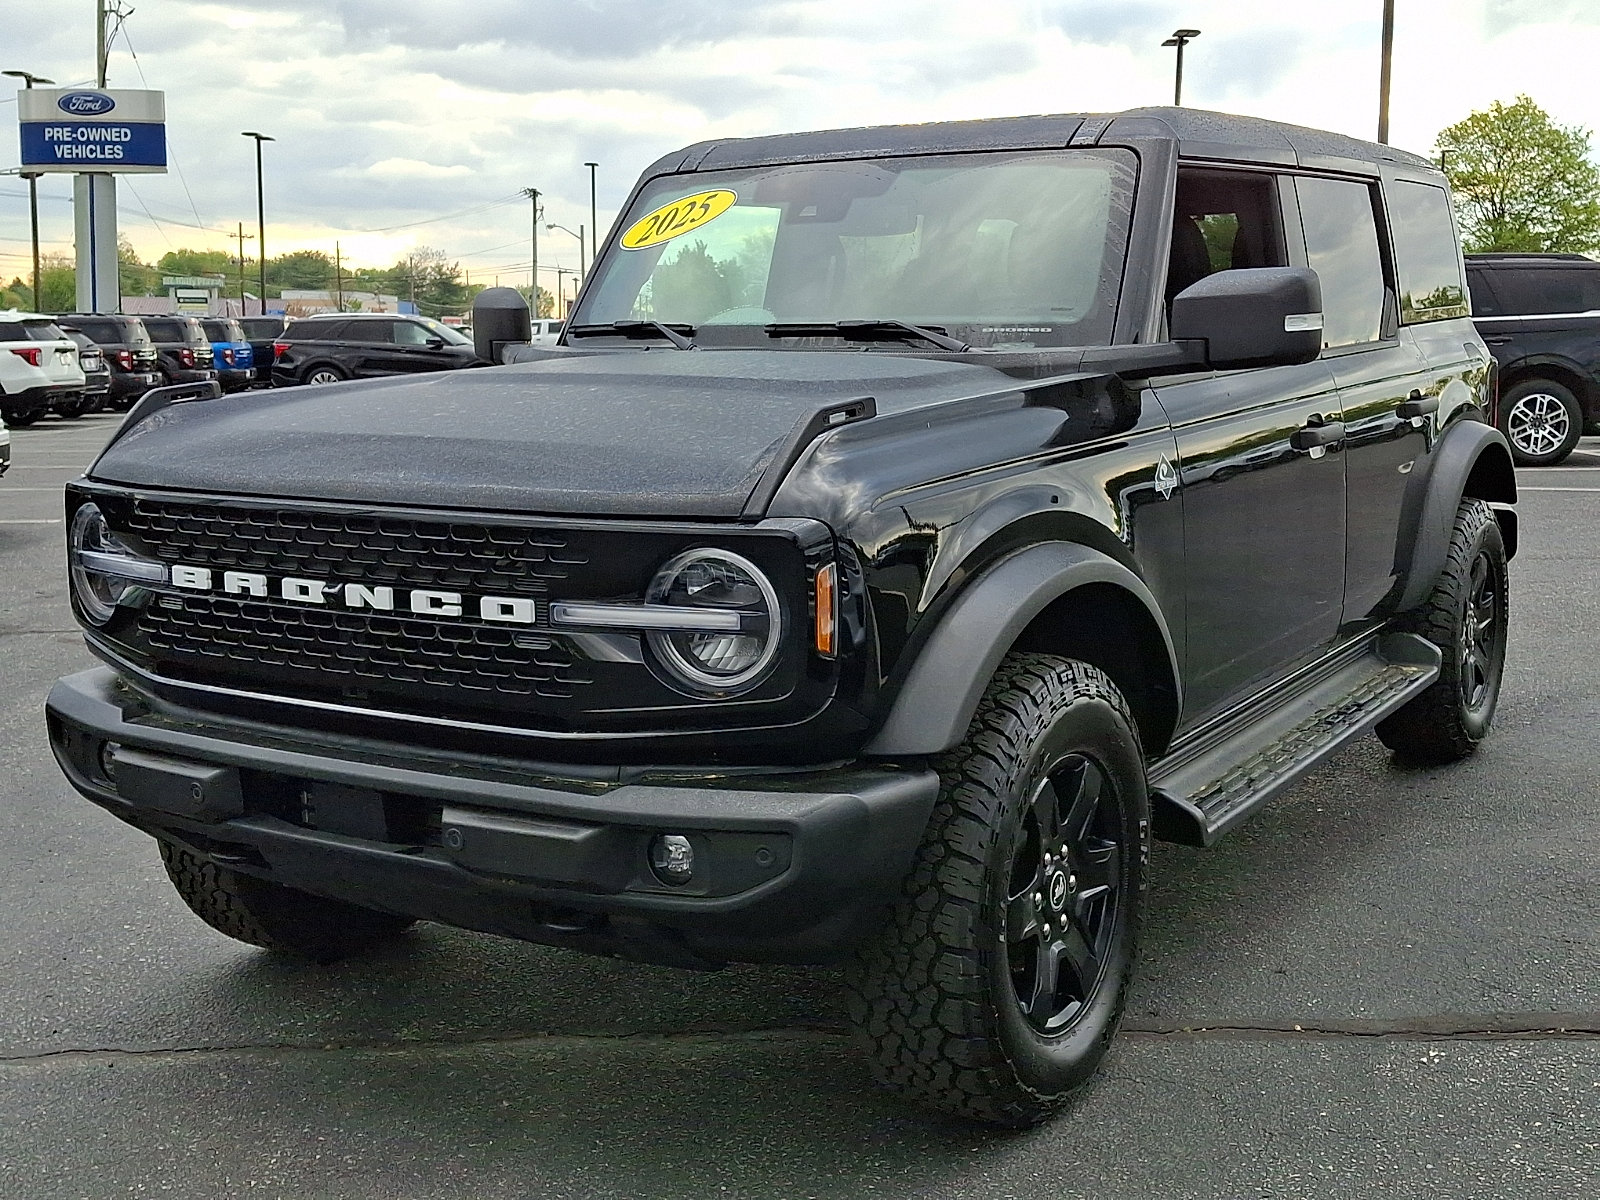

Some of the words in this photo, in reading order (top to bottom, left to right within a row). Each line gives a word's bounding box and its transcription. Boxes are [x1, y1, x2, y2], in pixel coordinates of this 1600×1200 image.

[44, 127, 131, 142] PRE-OWNED
[54, 144, 123, 159] VEHICLES
[634, 192, 719, 245] 2025
[171, 564, 536, 624] BRONCO
